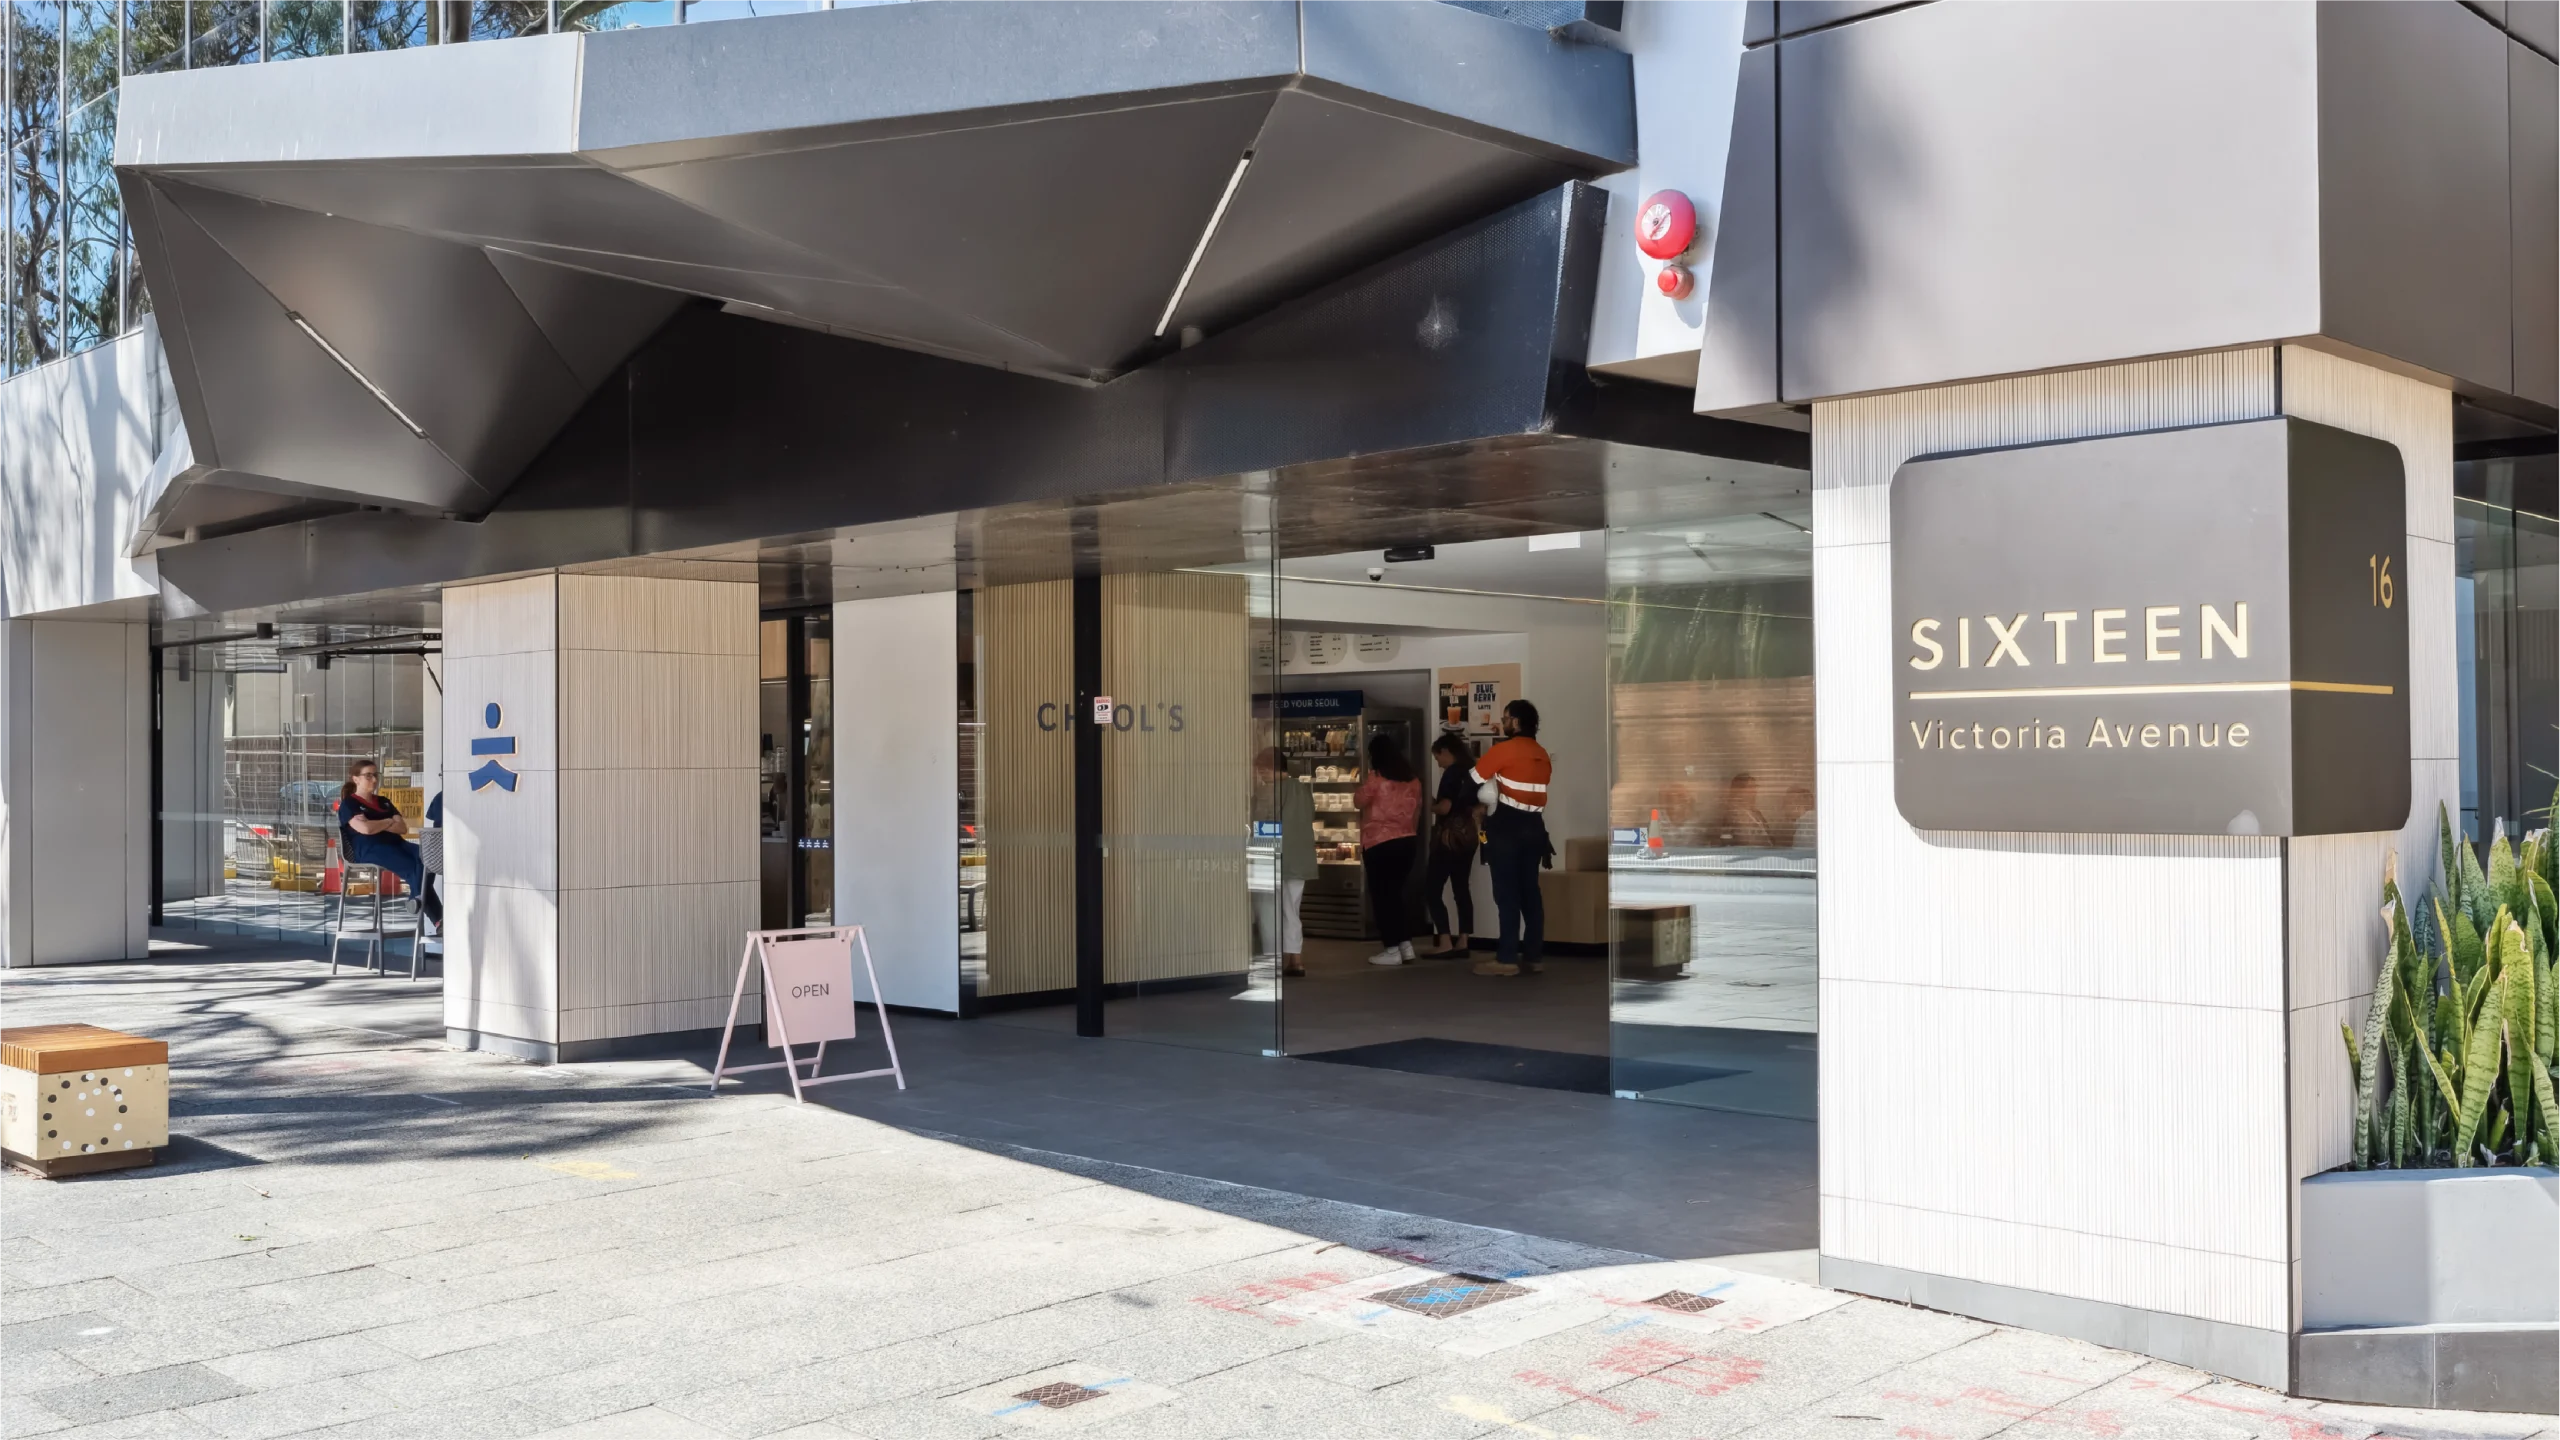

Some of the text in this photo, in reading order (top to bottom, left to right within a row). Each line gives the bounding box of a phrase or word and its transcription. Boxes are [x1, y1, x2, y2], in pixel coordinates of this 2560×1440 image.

[2369, 554, 2395, 609] 16
[1908, 600, 2250, 671] SIXTEEN
[1291, 699, 1313, 708] YOUR
[1314, 698, 1340, 707] SEOUL
[1476, 684, 1494, 693] BLUE
[1037, 702, 1184, 732] CHOL'S
[1910, 716, 2251, 750] Victoria Avenue
[791, 983, 830, 998] OPEN
